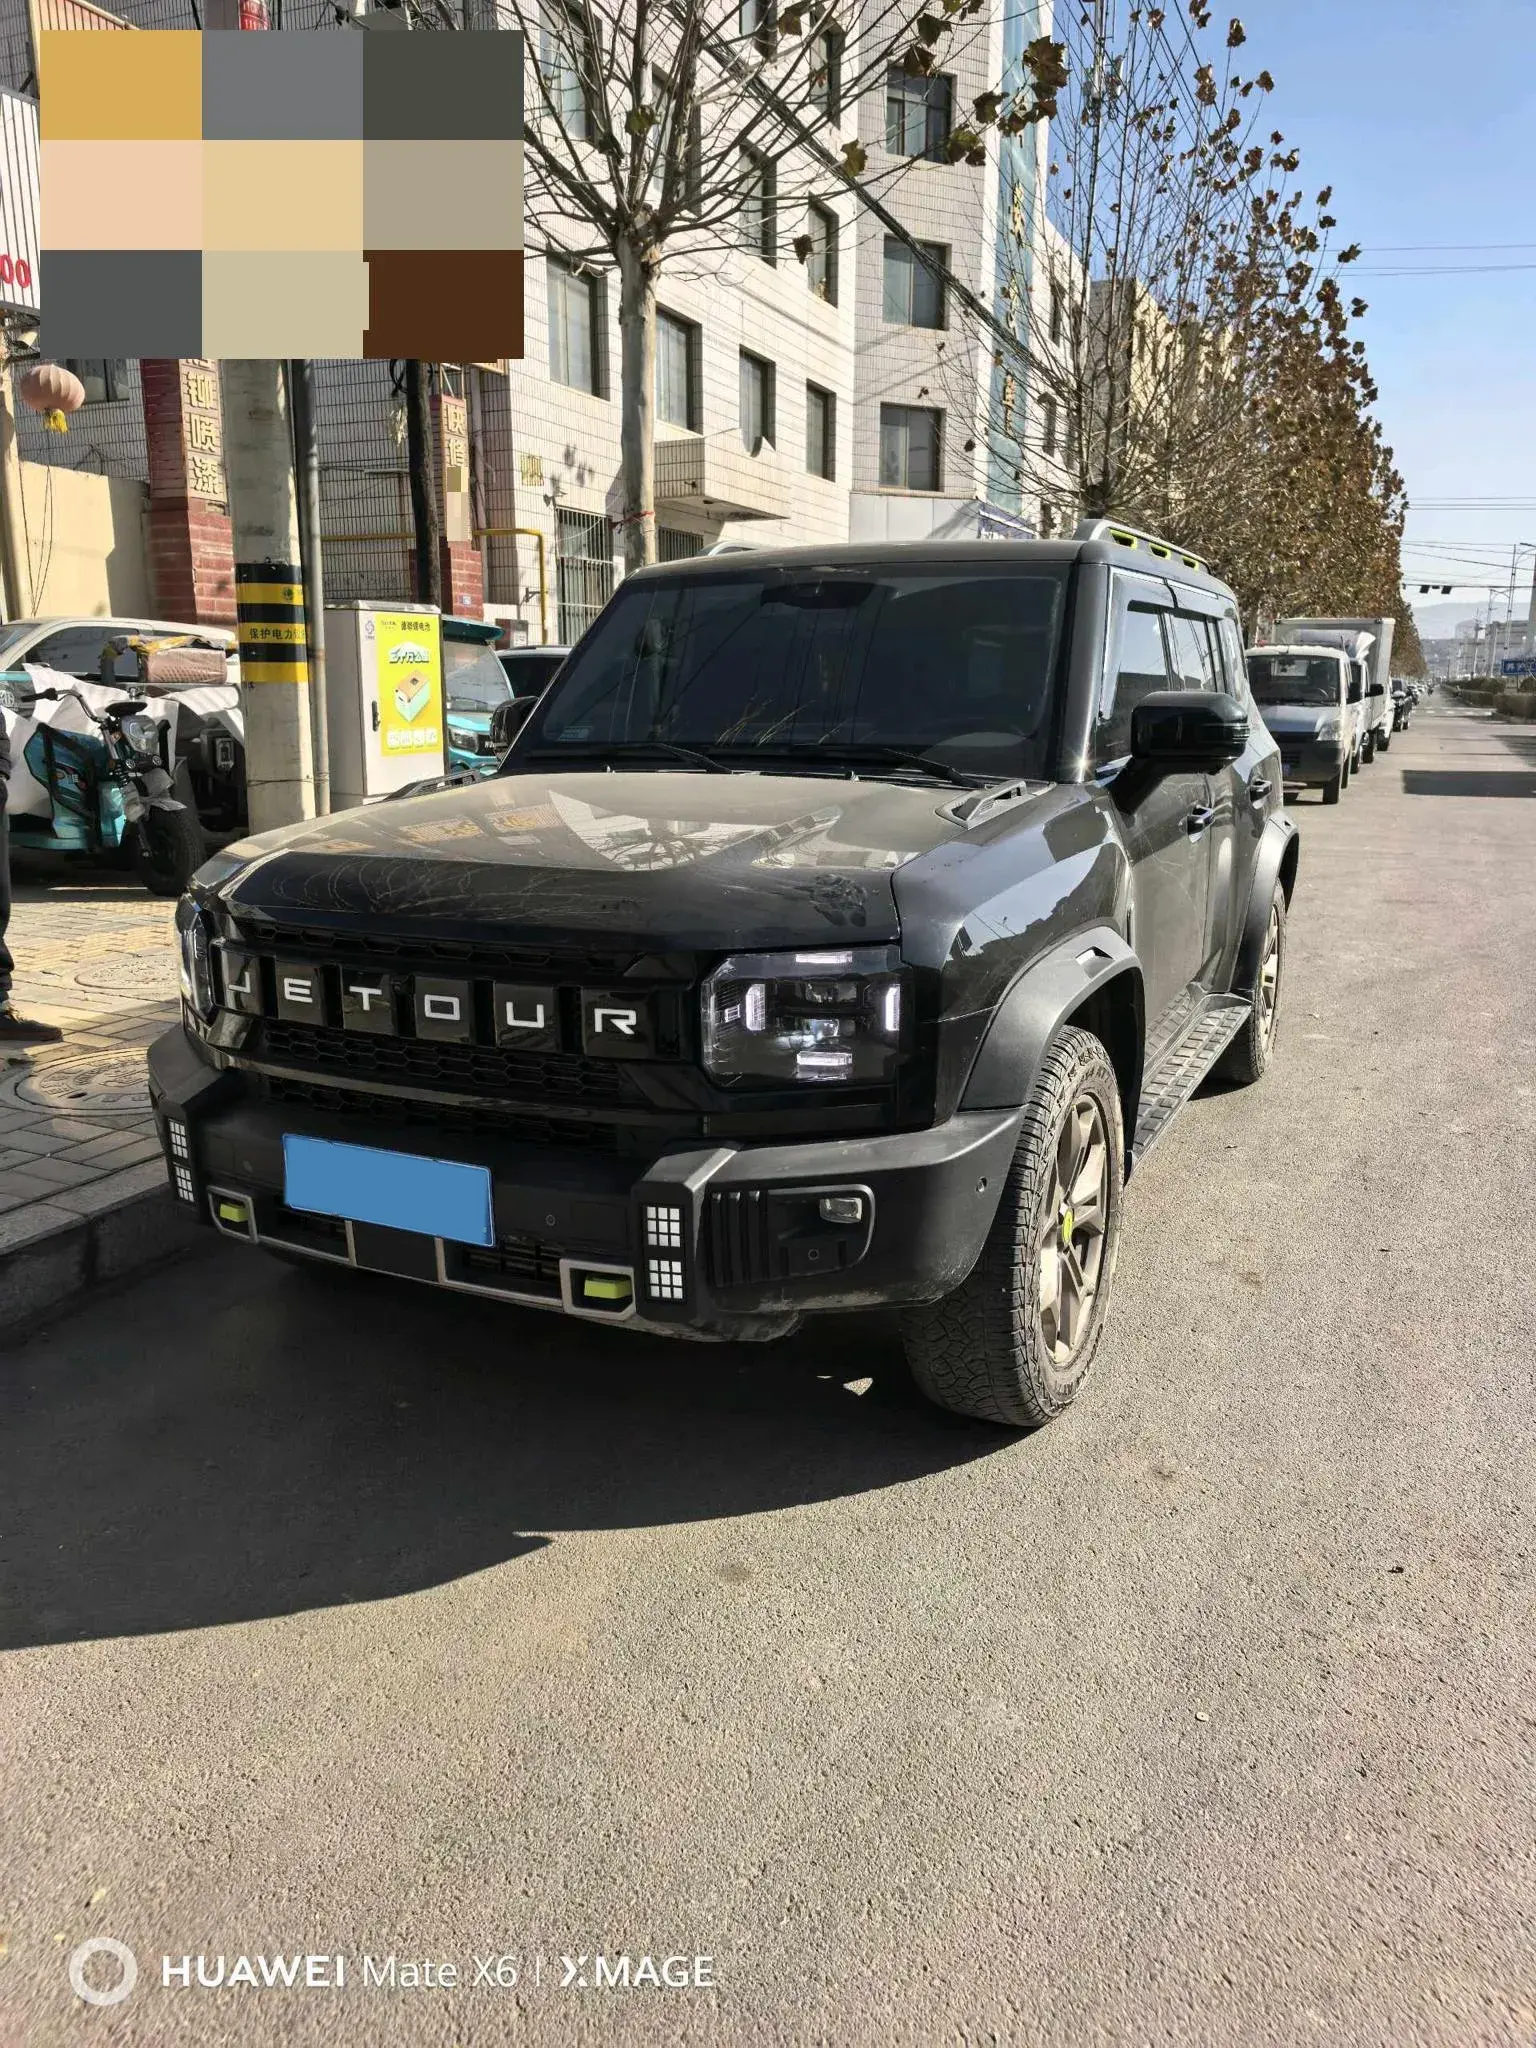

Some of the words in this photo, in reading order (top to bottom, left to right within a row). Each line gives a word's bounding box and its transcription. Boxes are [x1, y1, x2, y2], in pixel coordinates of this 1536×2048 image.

[184, 359, 219, 495] 铆喷漆
[228, 971, 638, 1035] JETOUR
